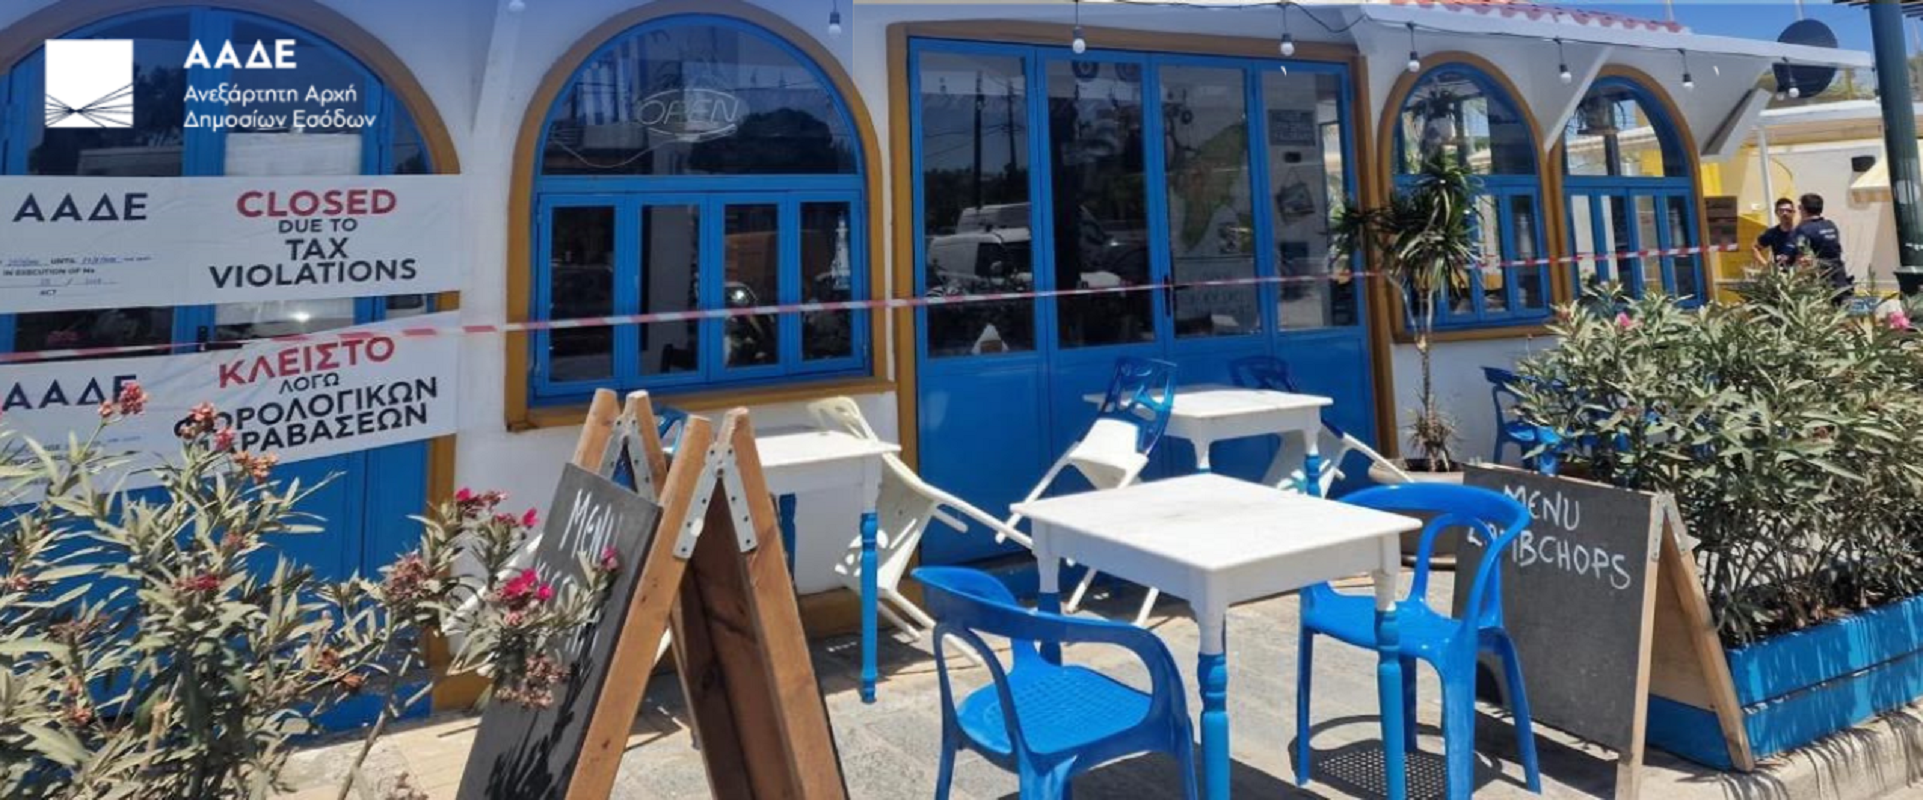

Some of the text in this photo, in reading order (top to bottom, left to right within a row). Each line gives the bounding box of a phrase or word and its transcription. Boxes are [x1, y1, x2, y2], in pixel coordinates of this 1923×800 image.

[637, 99, 739, 126] OPEN
[13, 192, 148, 222] ΑΑΔΕ
[236, 188, 397, 218] CLOSED
[278, 217, 358, 234] DUE TO
[286, 237, 350, 261] TAX
[209, 259, 417, 289] VIOLATIONS
[218, 336, 395, 389] ΚΛΕΙΣΤΟ
[279, 372, 340, 395] ΛΟΓΩ
